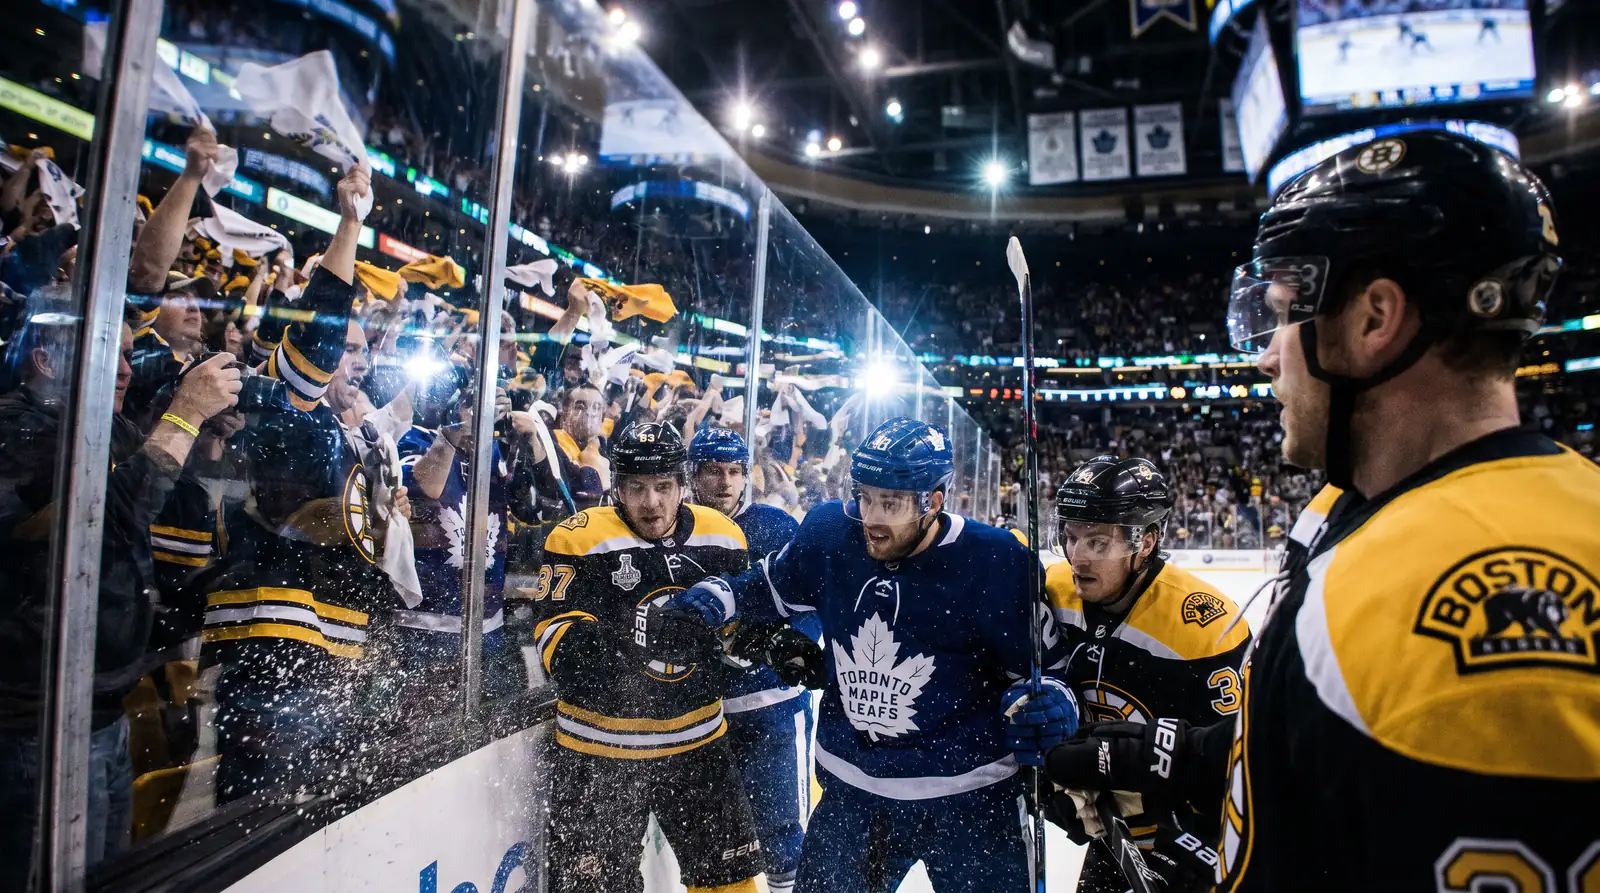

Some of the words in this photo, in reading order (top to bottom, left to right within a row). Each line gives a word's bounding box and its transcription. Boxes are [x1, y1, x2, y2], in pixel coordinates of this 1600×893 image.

[535, 564, 577, 602] 37
[1430, 558, 1600, 629] BOSTON
[840, 670, 912, 696] TORONTO
[848, 687, 899, 706] MAPLE
[848, 703, 898, 720] LEAFS
